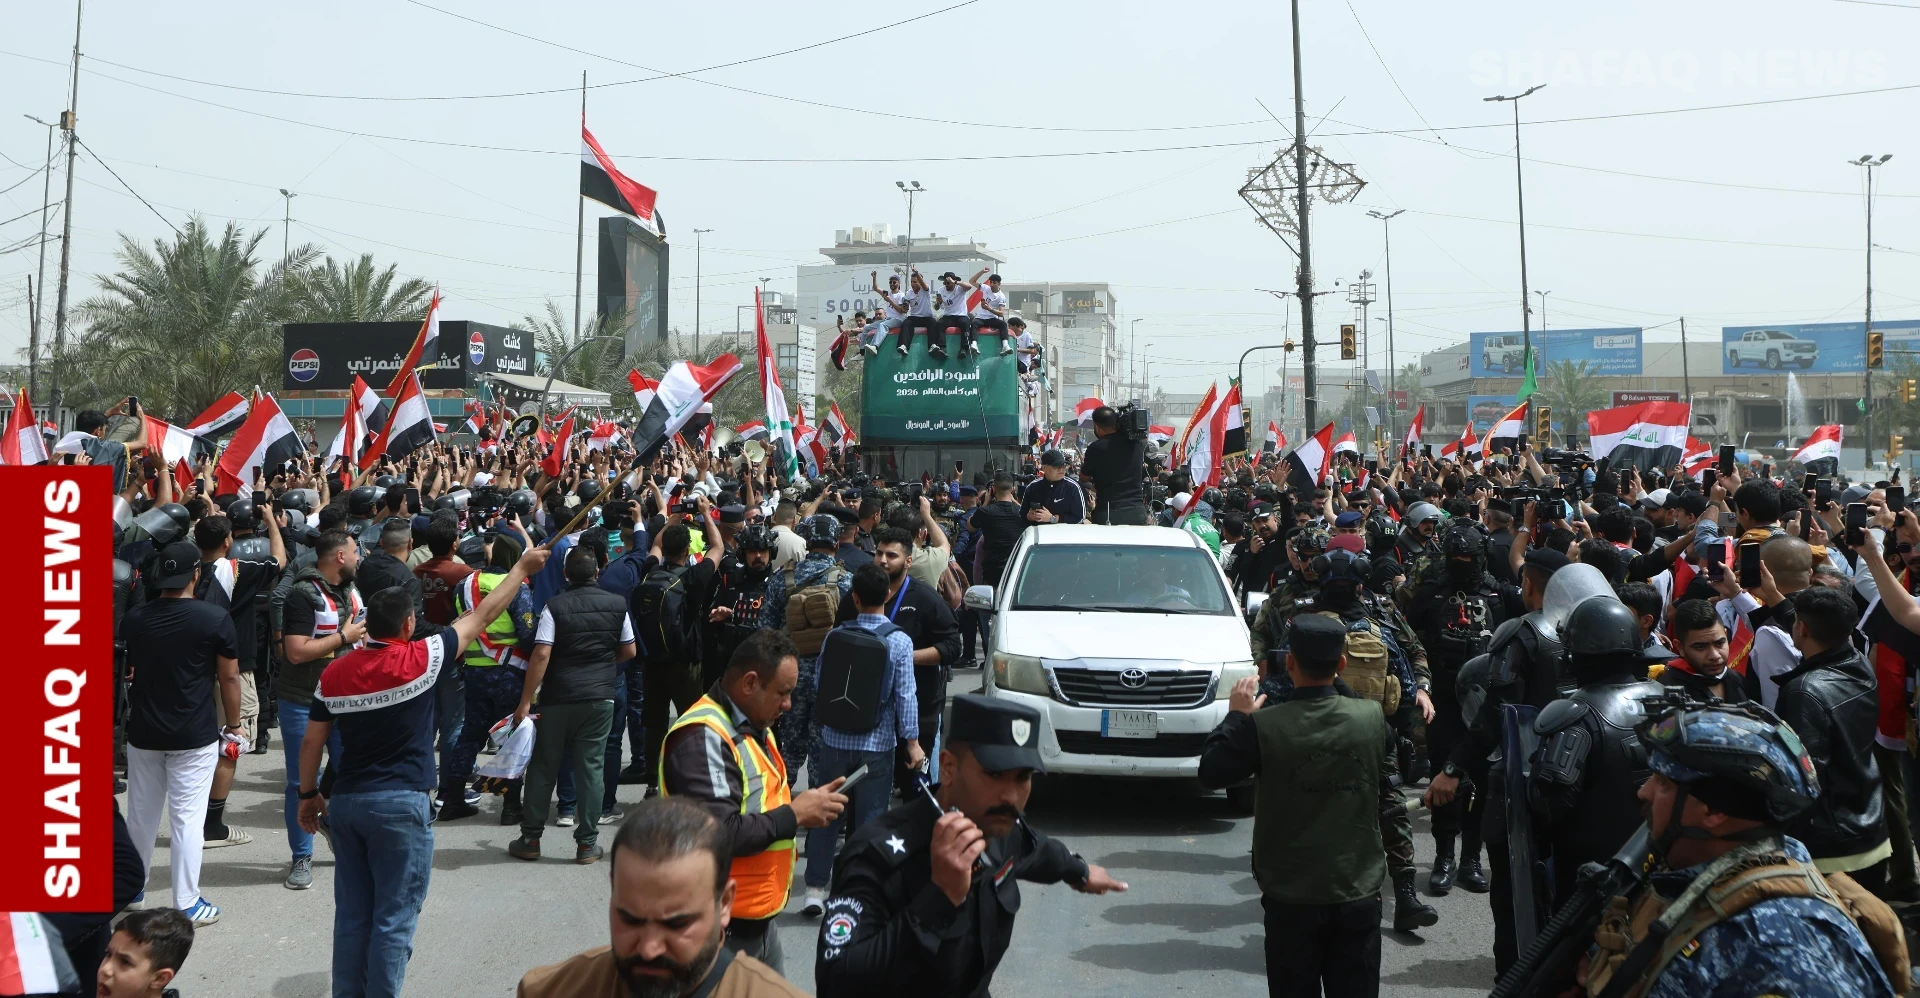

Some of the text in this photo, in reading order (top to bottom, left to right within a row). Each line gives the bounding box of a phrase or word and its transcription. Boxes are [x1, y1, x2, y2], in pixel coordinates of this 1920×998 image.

[826, 298, 878, 313] SOON
[503, 332, 521, 350] كشك
[470, 343, 484, 354] PEPSI
[291, 361, 319, 369] PEPSI
[347, 352, 461, 375] كش شمرتي
[496, 354, 527, 374] الشمرتي
[893, 365, 980, 383] أسود الرافدين
[896, 388, 918, 396] 2026
[922, 387, 943, 397] العالم
[1196, 524, 1219, 535] IRA
